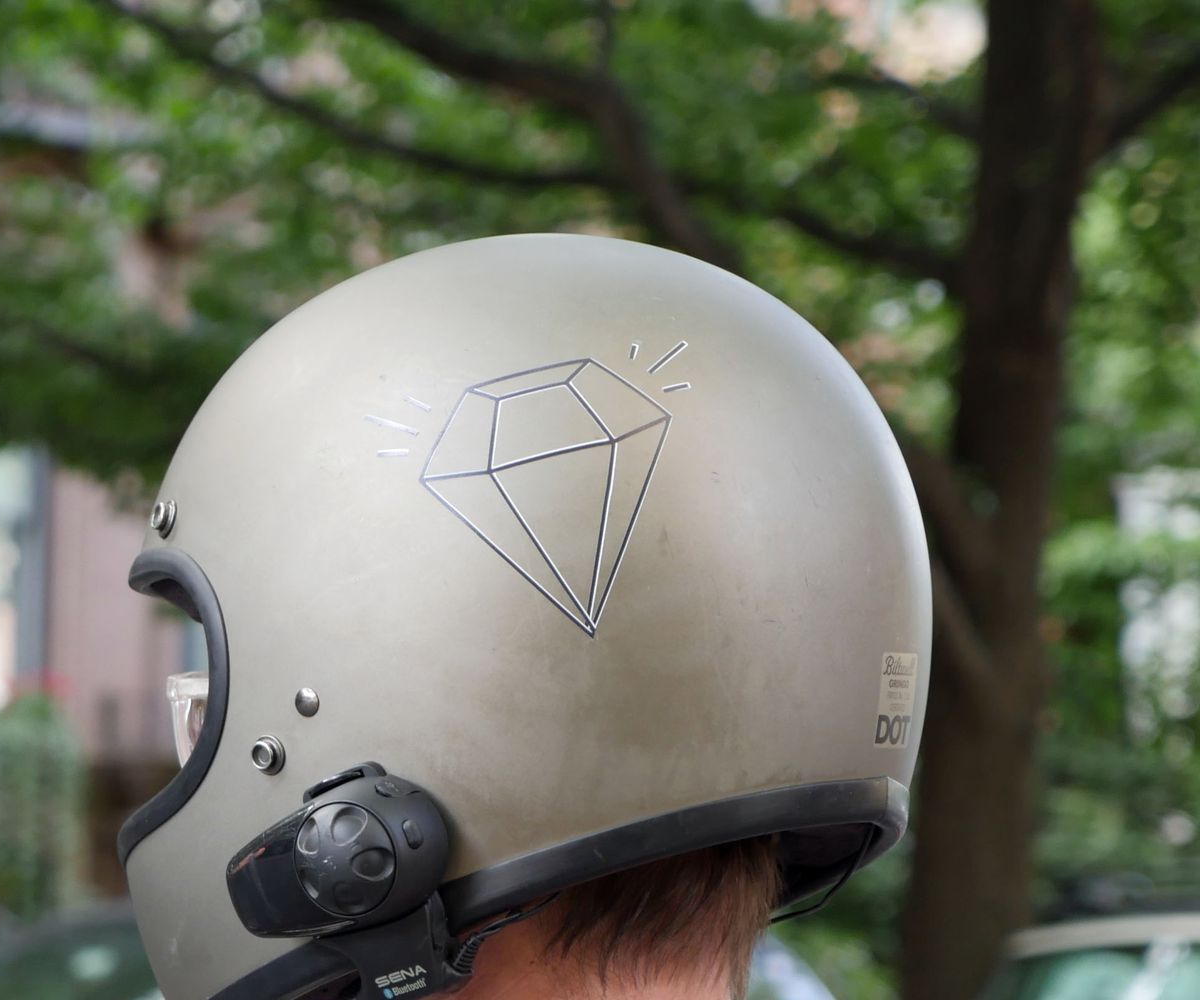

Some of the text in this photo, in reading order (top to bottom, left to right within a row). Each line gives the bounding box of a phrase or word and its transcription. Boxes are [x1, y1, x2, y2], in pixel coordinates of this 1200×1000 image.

[874, 714, 911, 745] DOT
[375, 965, 427, 988] SENA
[392, 979, 427, 997] Bluetooth
